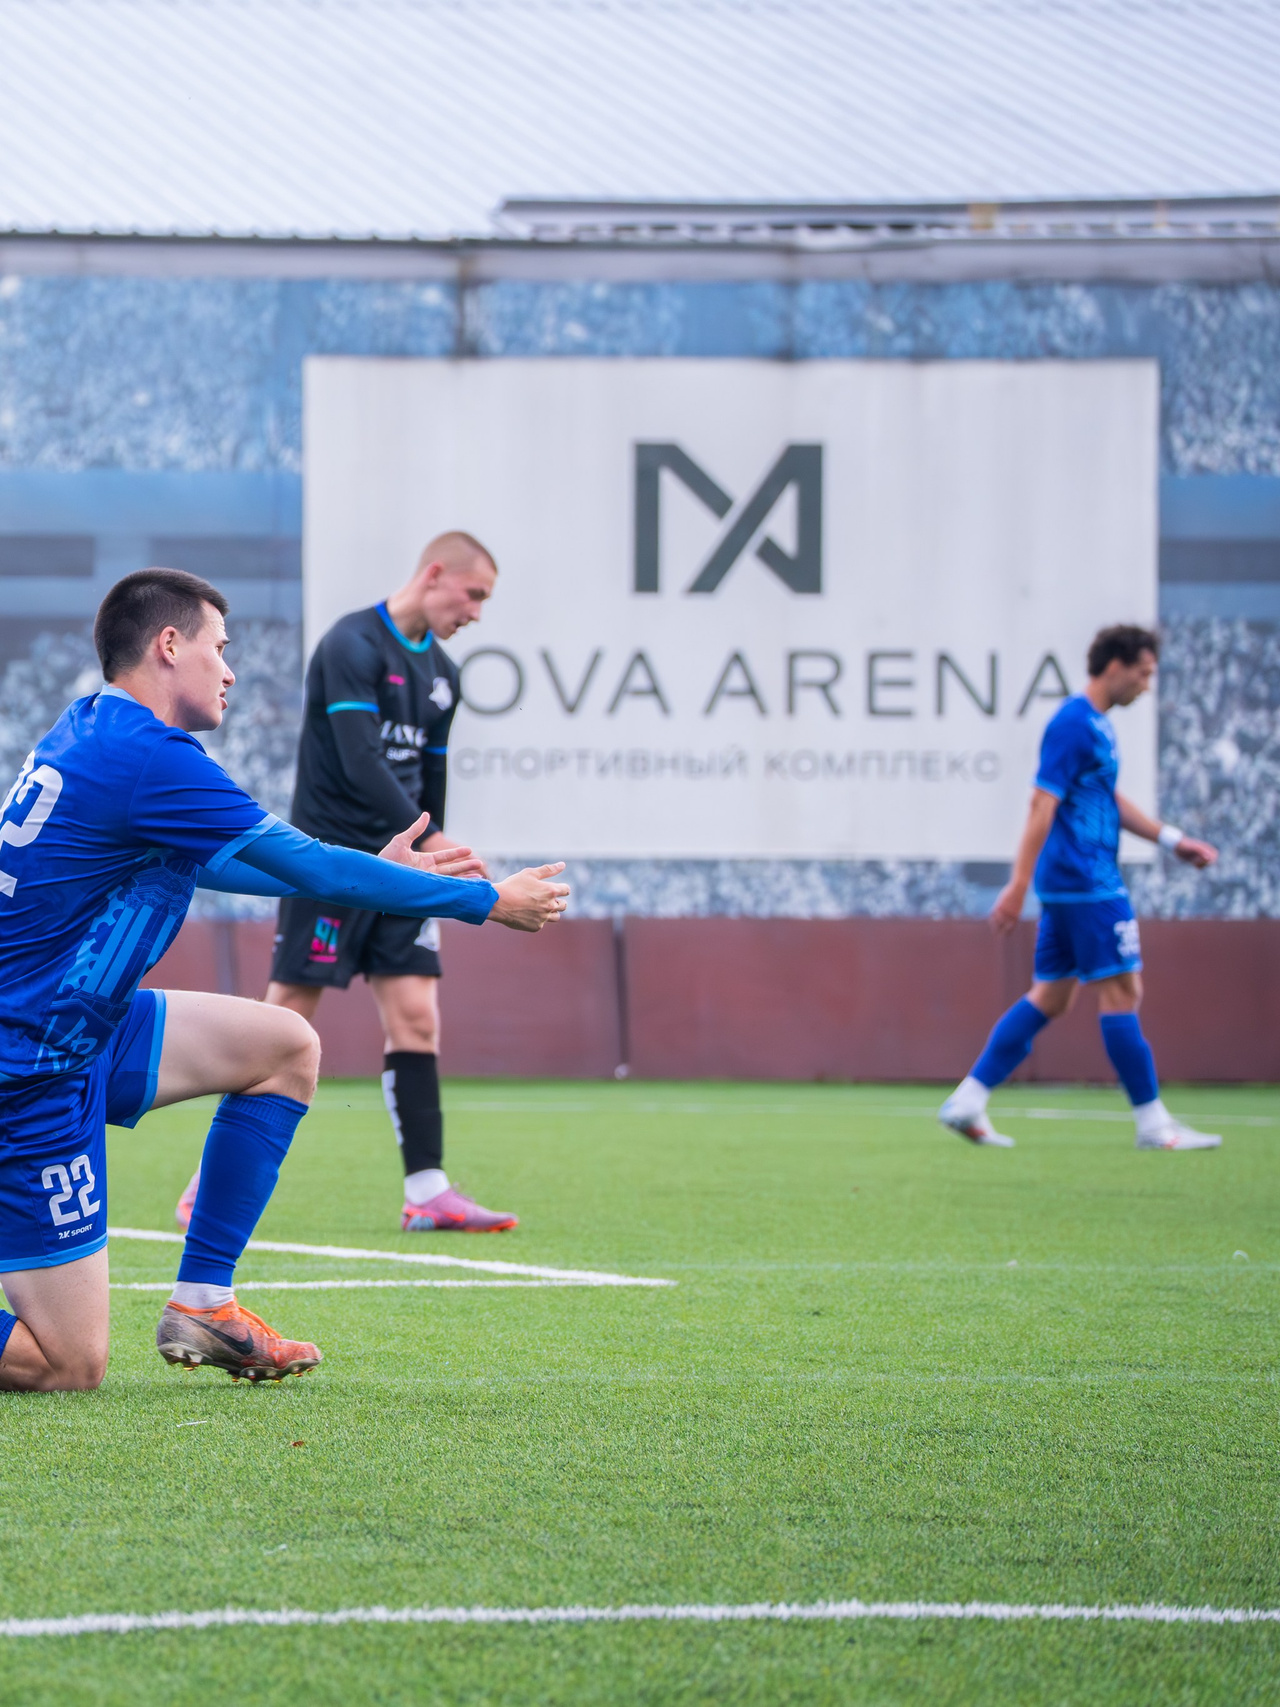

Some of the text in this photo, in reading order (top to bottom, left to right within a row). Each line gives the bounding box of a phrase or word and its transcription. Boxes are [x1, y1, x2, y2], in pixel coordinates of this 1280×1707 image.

[458, 646, 1070, 719] OVA ARENA
[453, 744, 1004, 785] СПОРТИВНЫЙ КОМПЛЕКС
[41, 1154, 100, 1226] 22
[71, 1223, 93, 1237] SPORT
